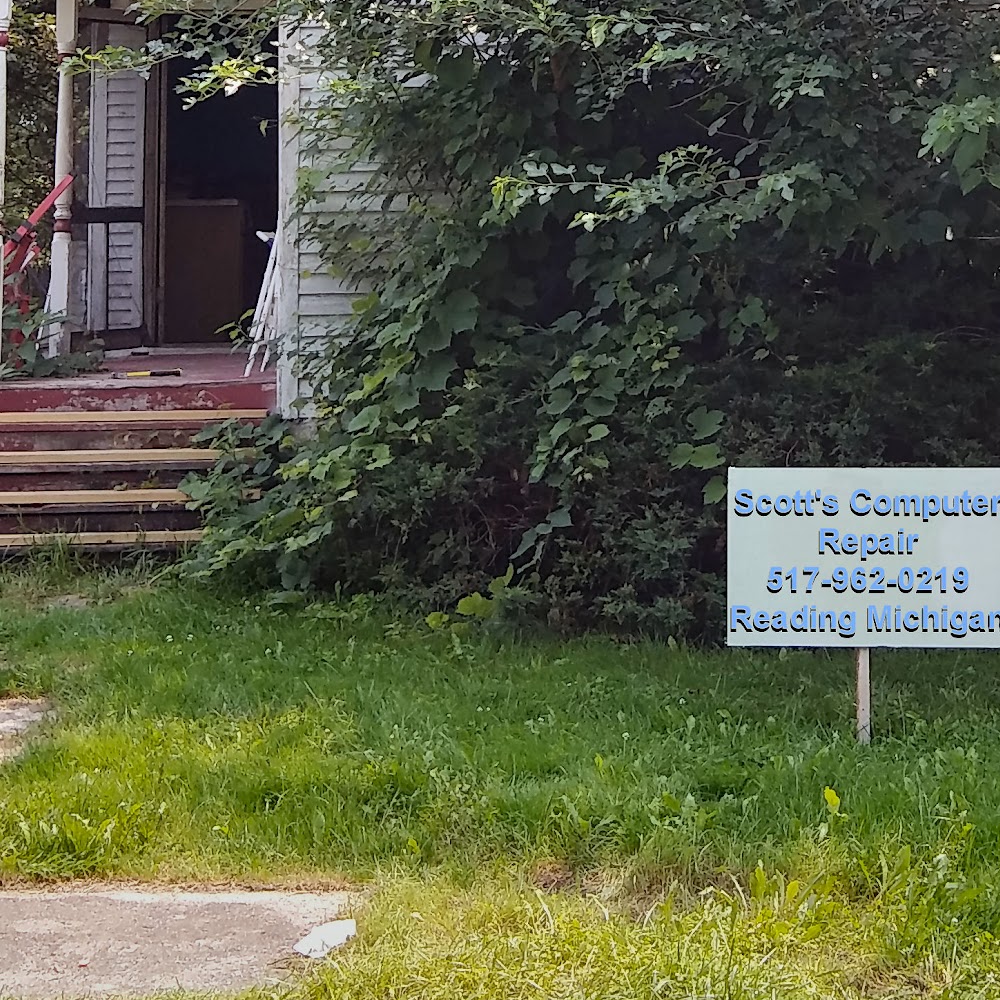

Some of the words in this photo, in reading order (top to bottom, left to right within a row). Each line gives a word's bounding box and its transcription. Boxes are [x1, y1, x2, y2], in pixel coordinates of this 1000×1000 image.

[734, 489, 839, 517] Scott's
[818, 528, 919, 561] Repair
[766, 566, 969, 593] 517-962-0219
[730, 605, 856, 637] Reading
